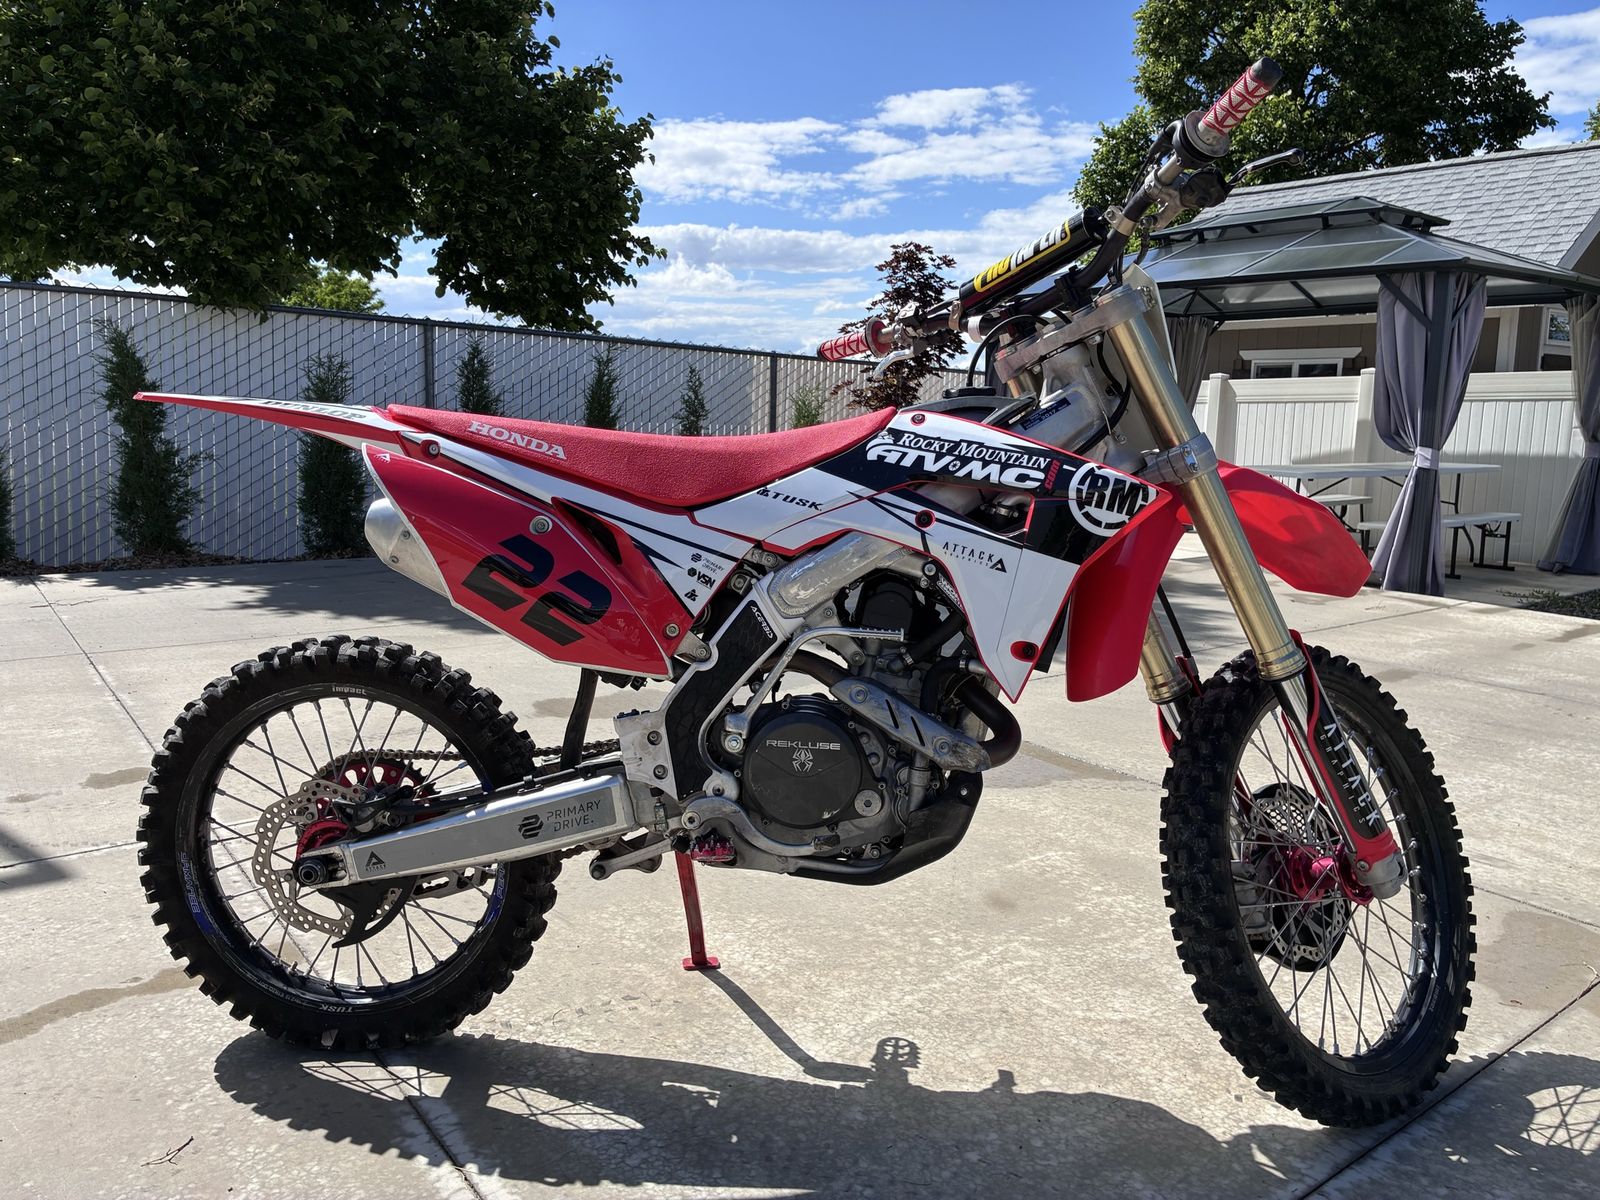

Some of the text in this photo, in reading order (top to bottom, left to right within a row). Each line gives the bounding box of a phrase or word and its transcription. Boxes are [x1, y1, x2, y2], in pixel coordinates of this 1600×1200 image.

[467, 420, 567, 460] HONDA
[897, 433, 1051, 469] ROCKY MOUNTAIN
[771, 491, 824, 511] TUSK
[942, 541, 995, 563] ATTACK
[461, 534, 612, 646] 22
[697, 571, 716, 588] VSN
[766, 740, 841, 751] REKLUSE
[1320, 734, 1366, 824] GRAPHICS
[1324, 723, 1380, 826] ATTACK
[546, 799, 601, 821] PRIMARY
